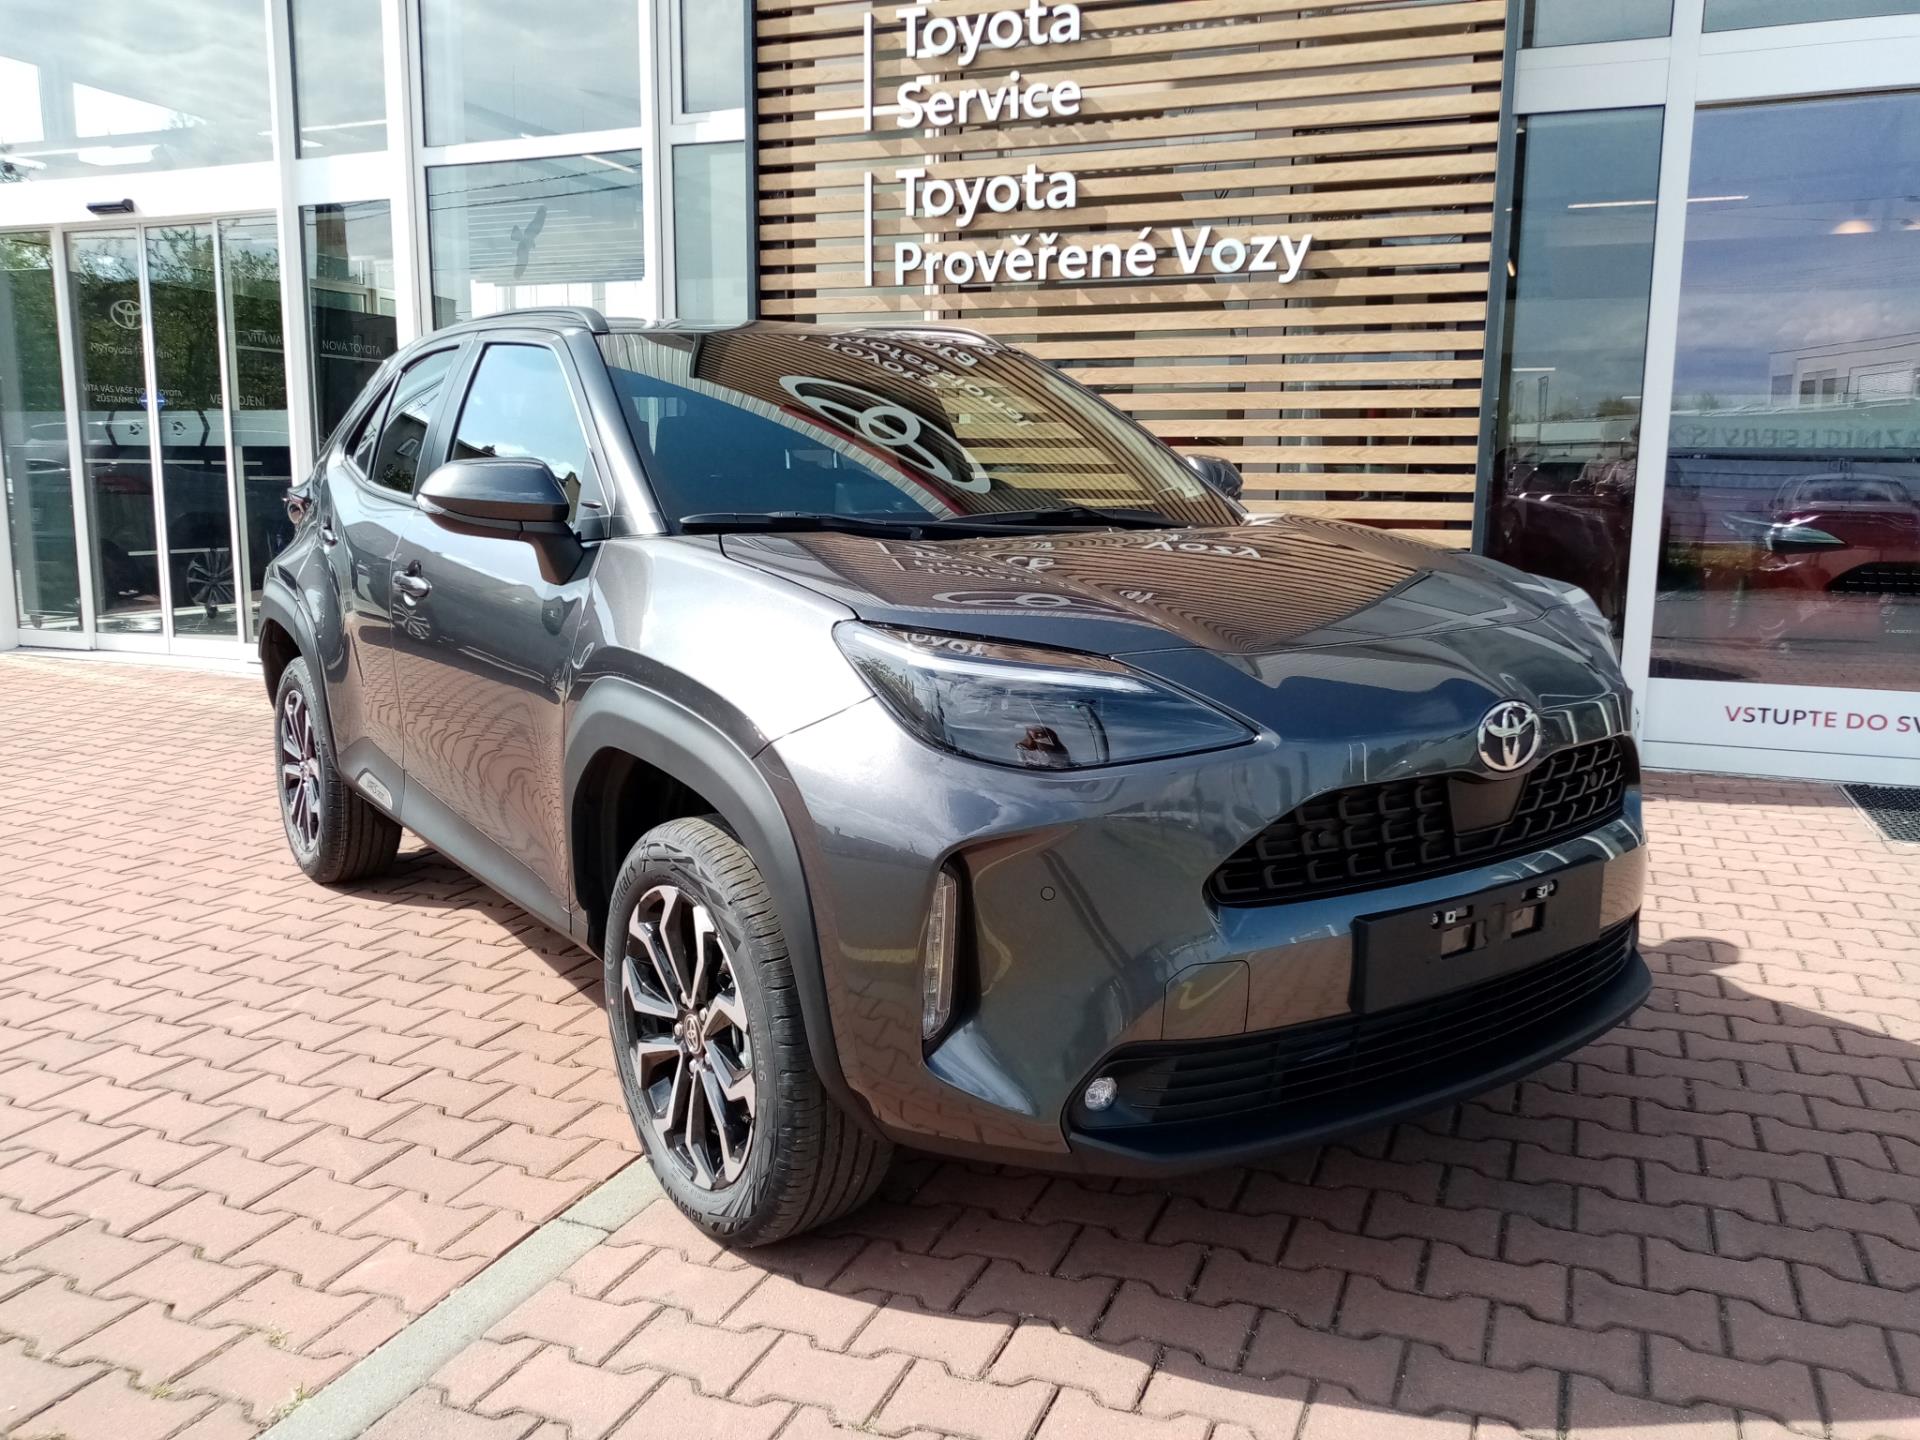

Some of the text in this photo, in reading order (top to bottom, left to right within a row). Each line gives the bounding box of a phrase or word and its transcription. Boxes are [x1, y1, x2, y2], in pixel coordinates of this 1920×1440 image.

[896, 0, 1081, 66] Toyota
[896, 70, 1082, 129] Service
[896, 163, 1078, 227] Toyota
[894, 225, 1313, 286] Prověřené Vozy
[1725, 705, 1838, 728] VSTUPTE
[1846, 712, 1888, 731] DO
